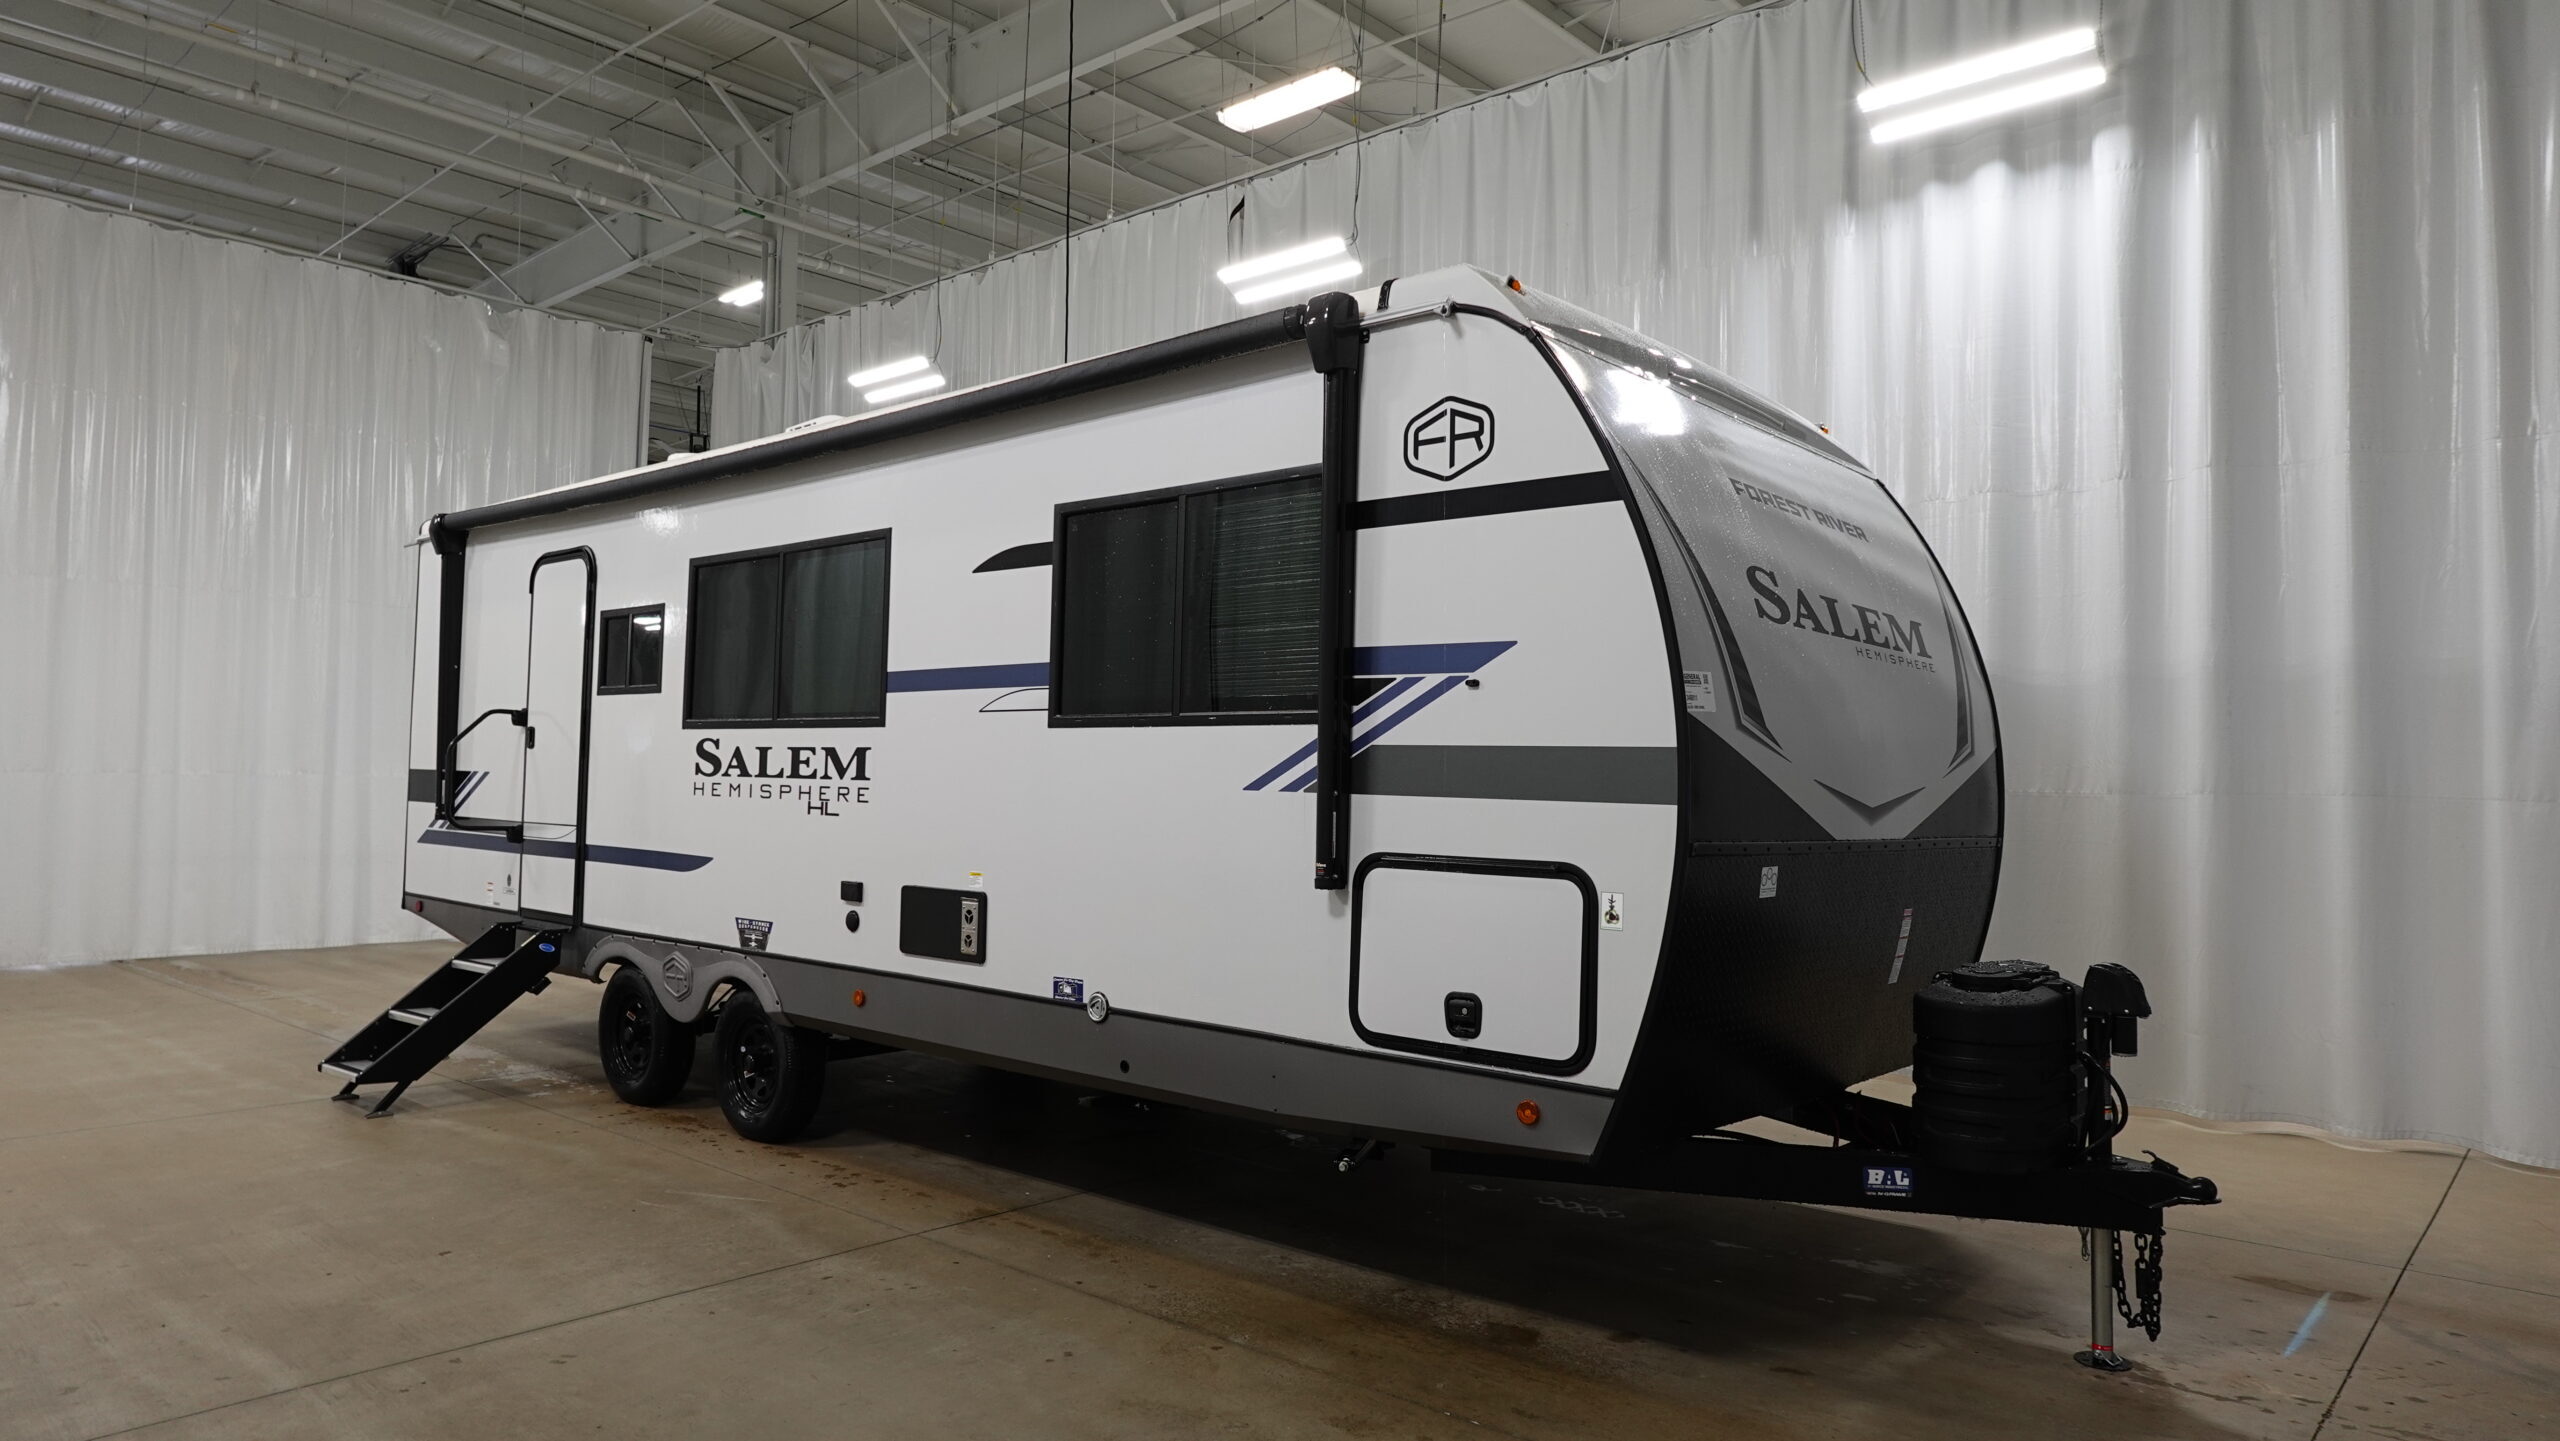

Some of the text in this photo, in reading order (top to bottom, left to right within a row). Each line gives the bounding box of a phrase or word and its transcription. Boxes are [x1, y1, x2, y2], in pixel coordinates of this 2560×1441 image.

[1413, 407, 1485, 469] FR
[1728, 477, 1869, 543] FOREST RIVER
[1855, 646, 1936, 673] HEMISPHERE
[693, 781, 870, 803] HEMISPHERE
[807, 800, 840, 816] HL
[1867, 1168, 1910, 1186] BAL
